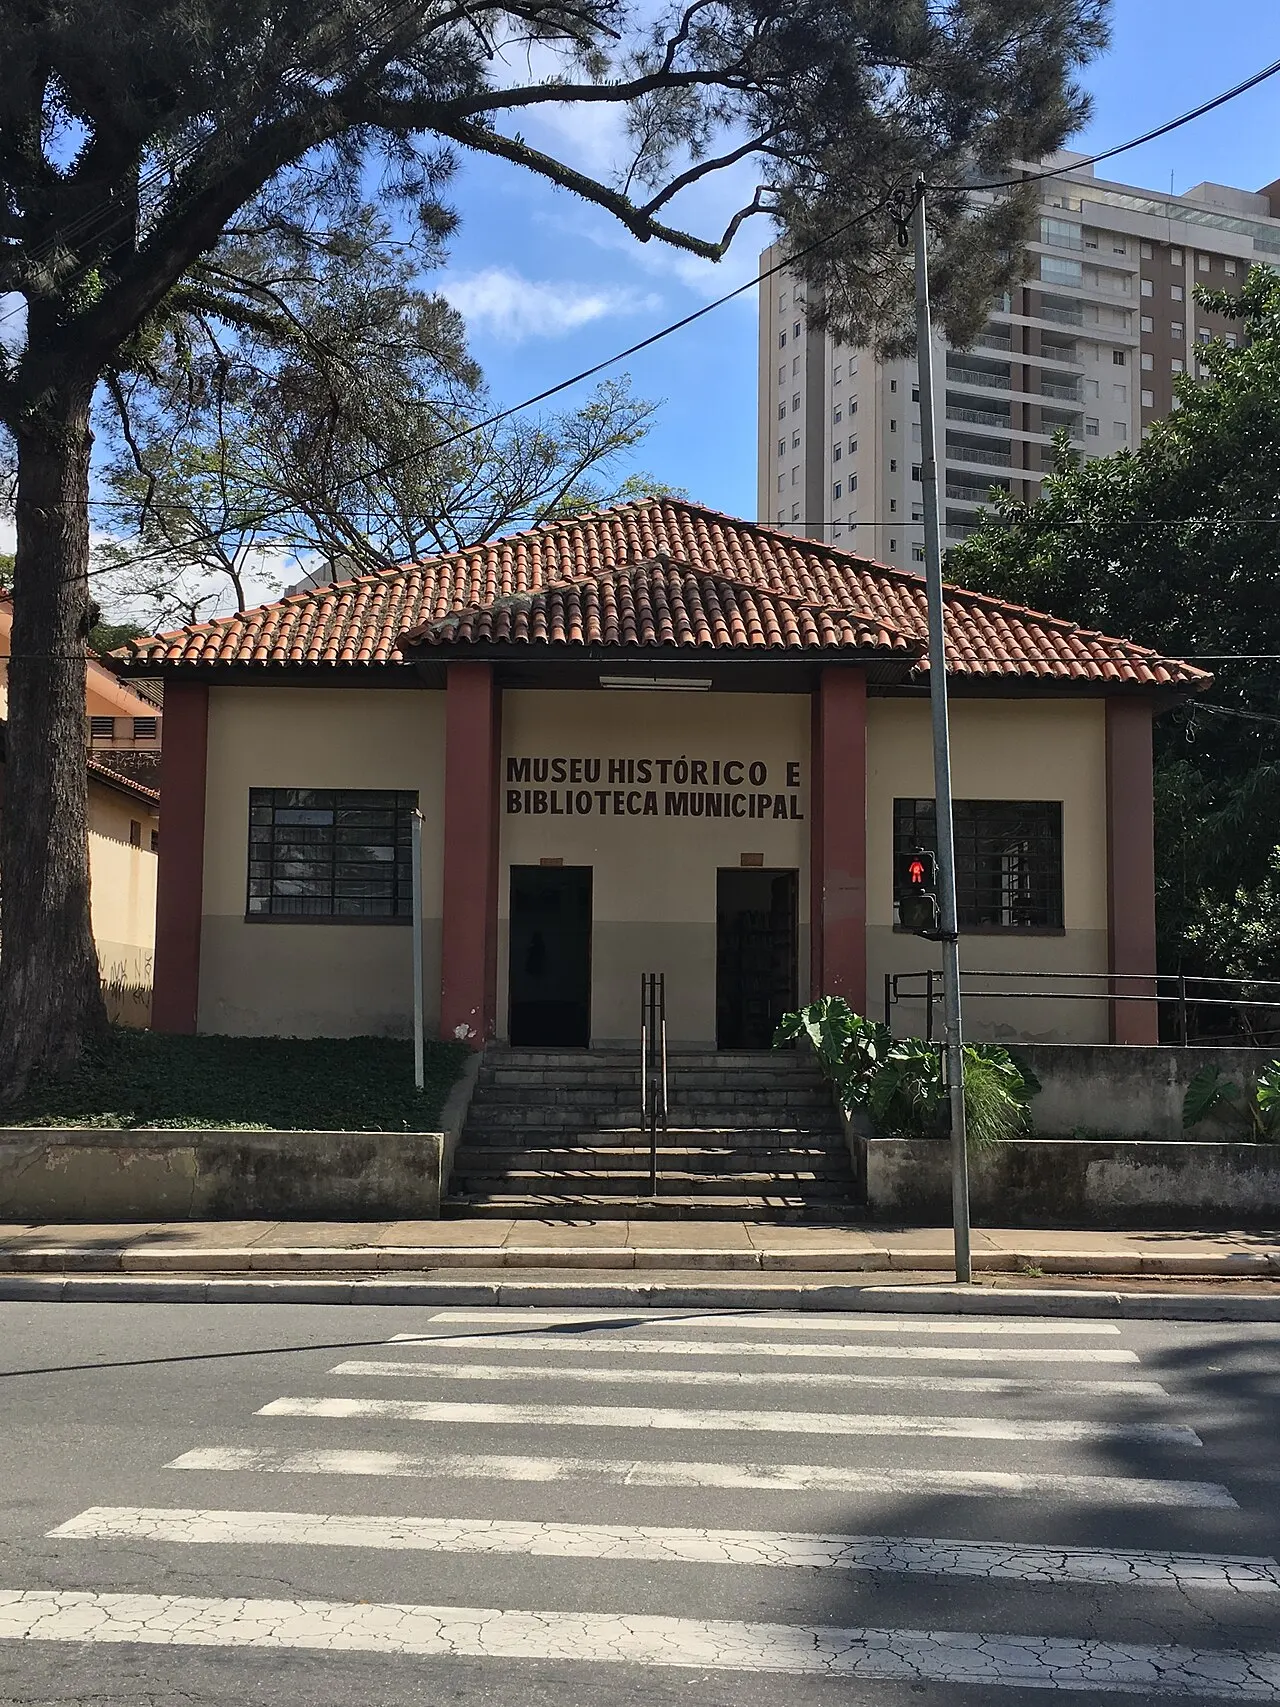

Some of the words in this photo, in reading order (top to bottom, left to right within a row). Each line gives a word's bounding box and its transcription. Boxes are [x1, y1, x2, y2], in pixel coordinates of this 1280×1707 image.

[506, 757, 601, 783] MUSEU
[608, 754, 767, 787] HISTÓRICO
[786, 761, 801, 787] E
[506, 789, 658, 816] BIBLIOTECA
[665, 791, 804, 820] MUNICIPAL
